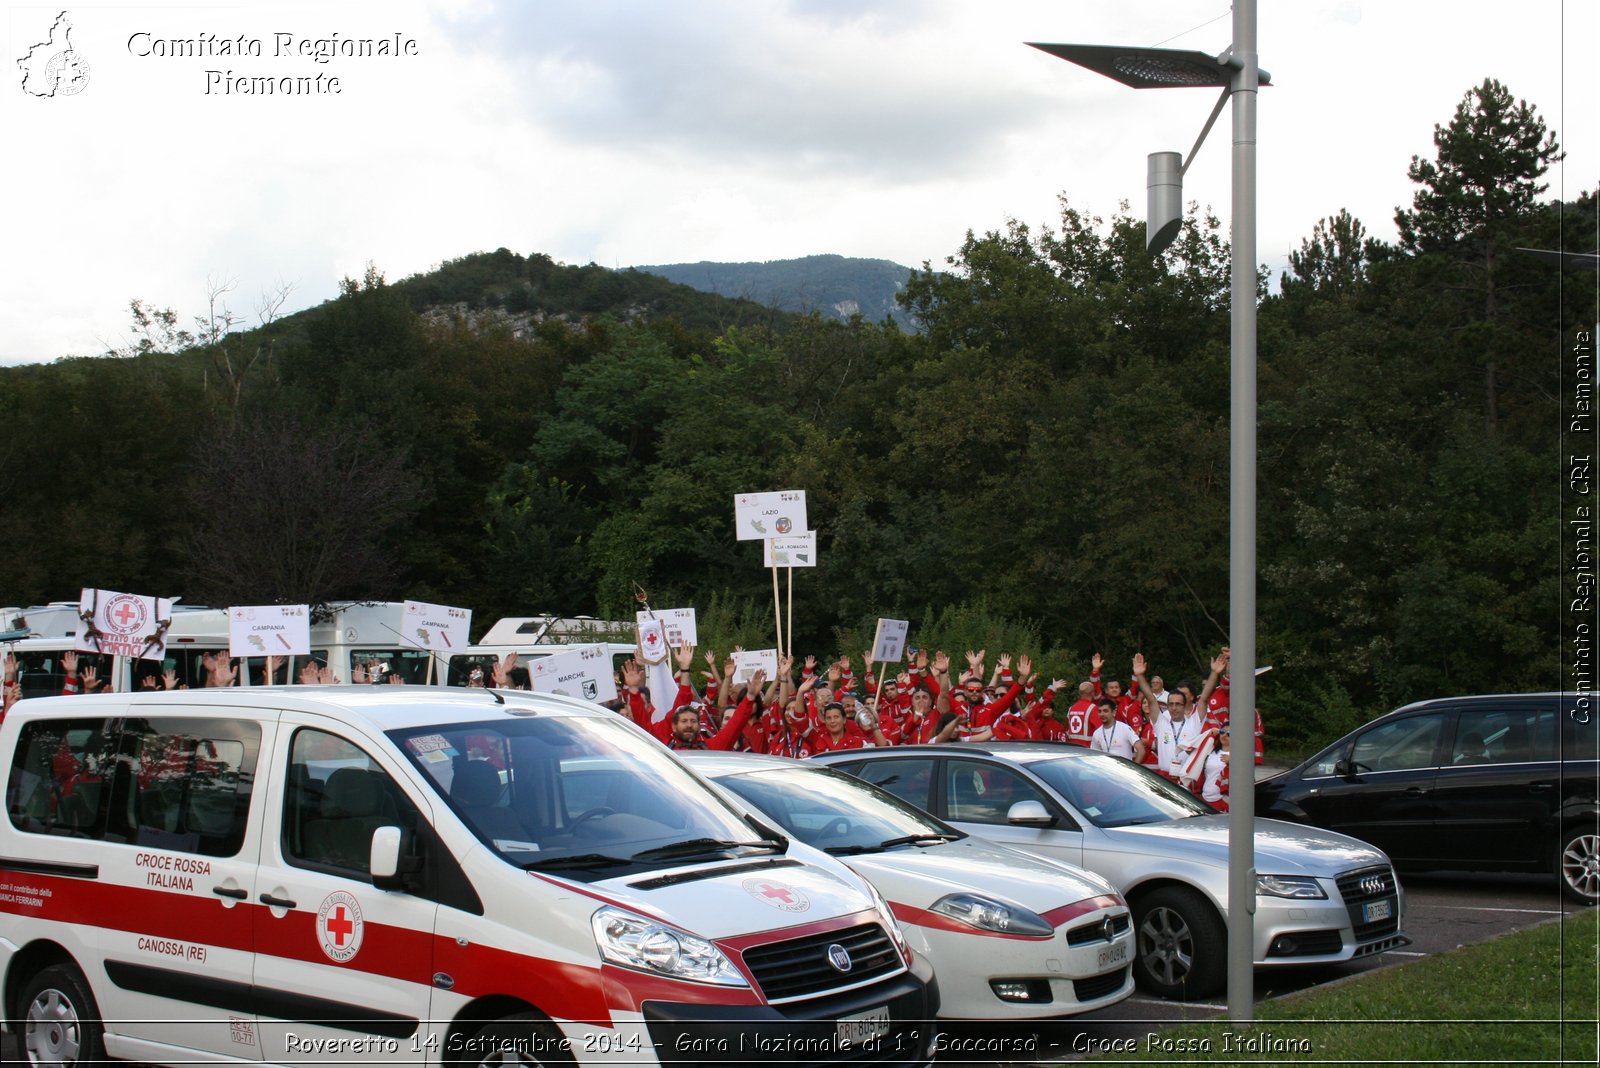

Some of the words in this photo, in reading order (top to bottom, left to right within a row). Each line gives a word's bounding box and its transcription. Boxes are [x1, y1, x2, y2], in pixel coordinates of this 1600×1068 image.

[421, 620, 450, 629] CAMPANIA
[558, 671, 586, 683] MARCHE
[135, 853, 172, 871] CROCE
[174, 858, 211, 876] ROSSA
[147, 872, 194, 891] ITALIANA
[14, 885, 39, 895] contributo
[138, 937, 184, 957] CANOSSA
[186, 946, 207, 964] (RE)
[325, 943, 356, 960] CANOSSA
[232, 1031, 252, 1044] 10-77
